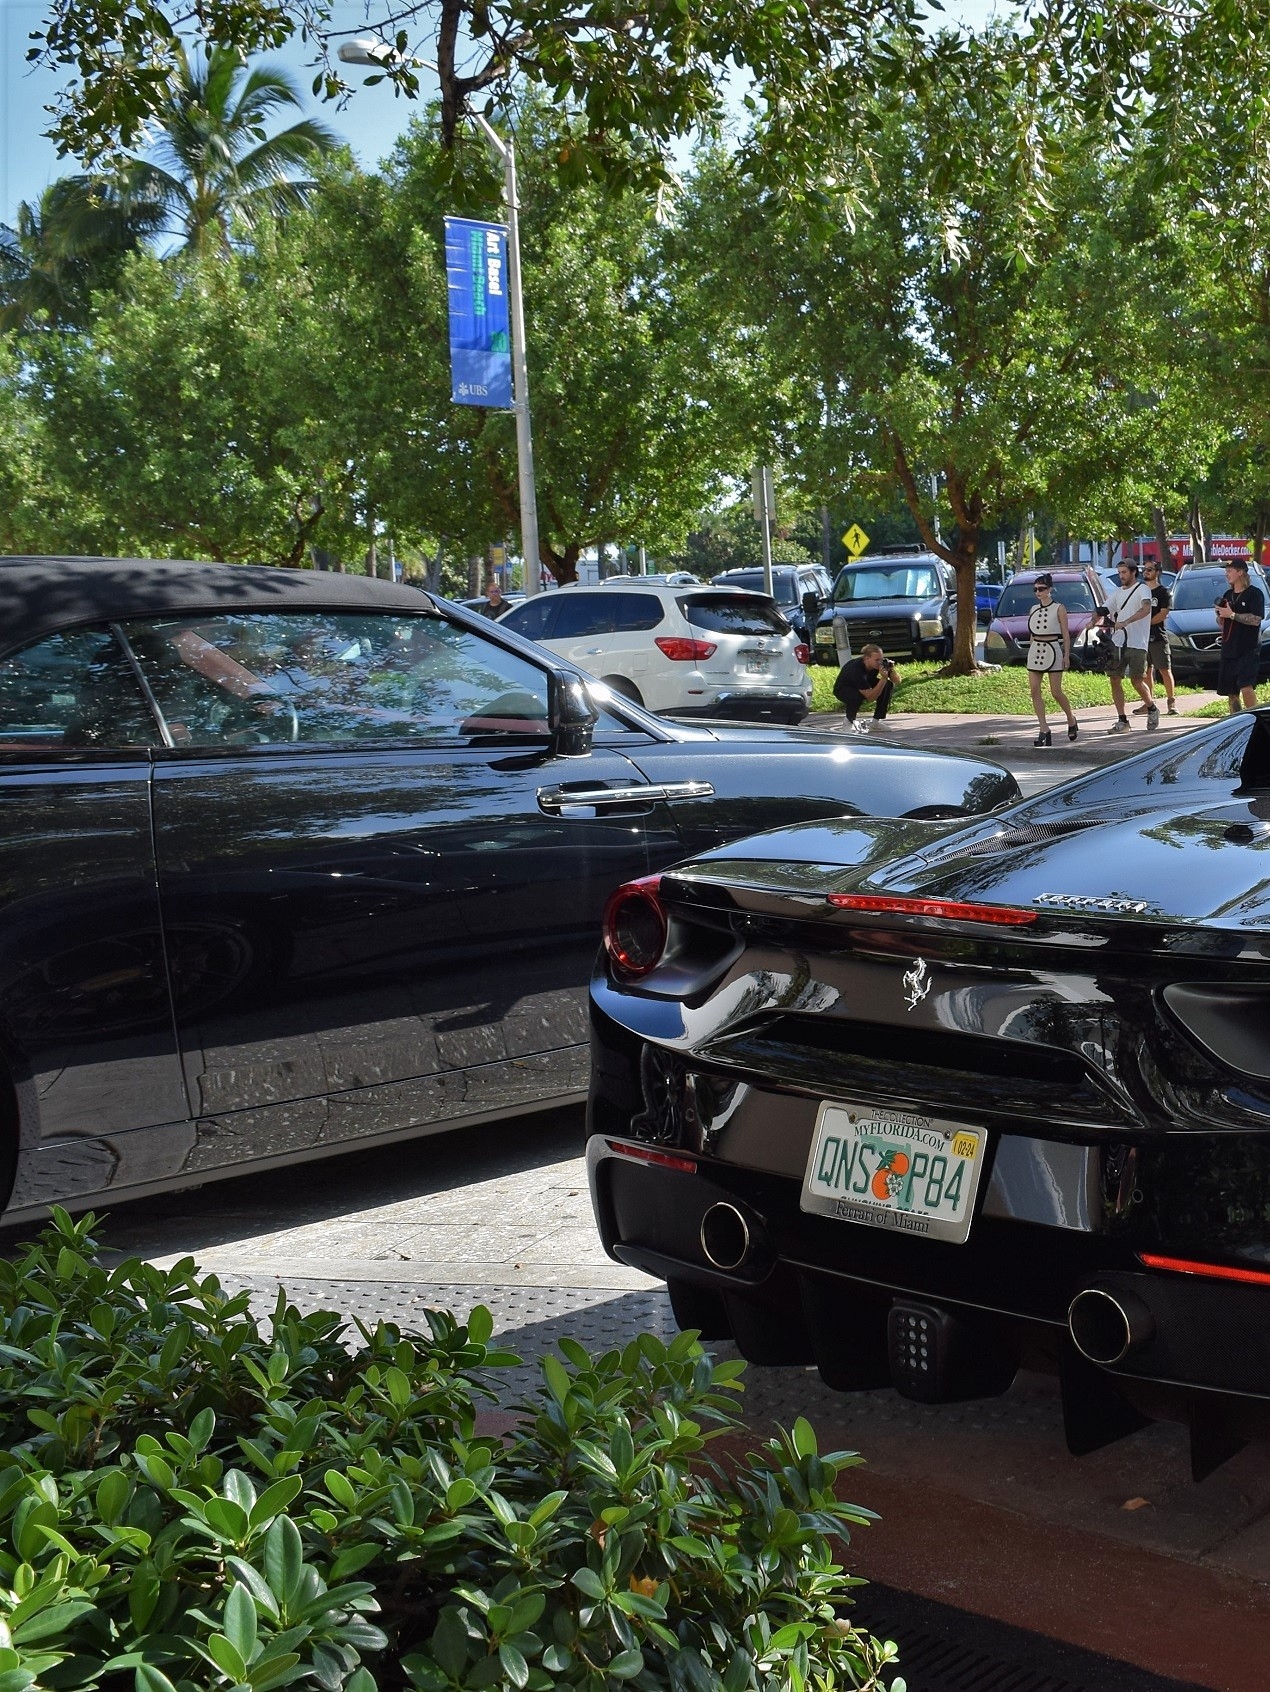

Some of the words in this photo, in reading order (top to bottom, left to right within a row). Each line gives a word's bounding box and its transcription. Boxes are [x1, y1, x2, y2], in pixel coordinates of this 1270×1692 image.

[470, 230, 485, 273] Miami
[486, 229, 500, 254] Art
[487, 258, 503, 296] Basel
[473, 274, 487, 316] Beach
[470, 384, 488, 396] UBS
[854, 1122, 946, 1152] MYFLORIDA.COM
[817, 1135, 876, 1194] QNS
[905, 1151, 966, 1212] P84
[836, 1201, 874, 1221] Ferrari
[875, 1211, 889, 1225] of
[891, 1211, 930, 1234] Miami
